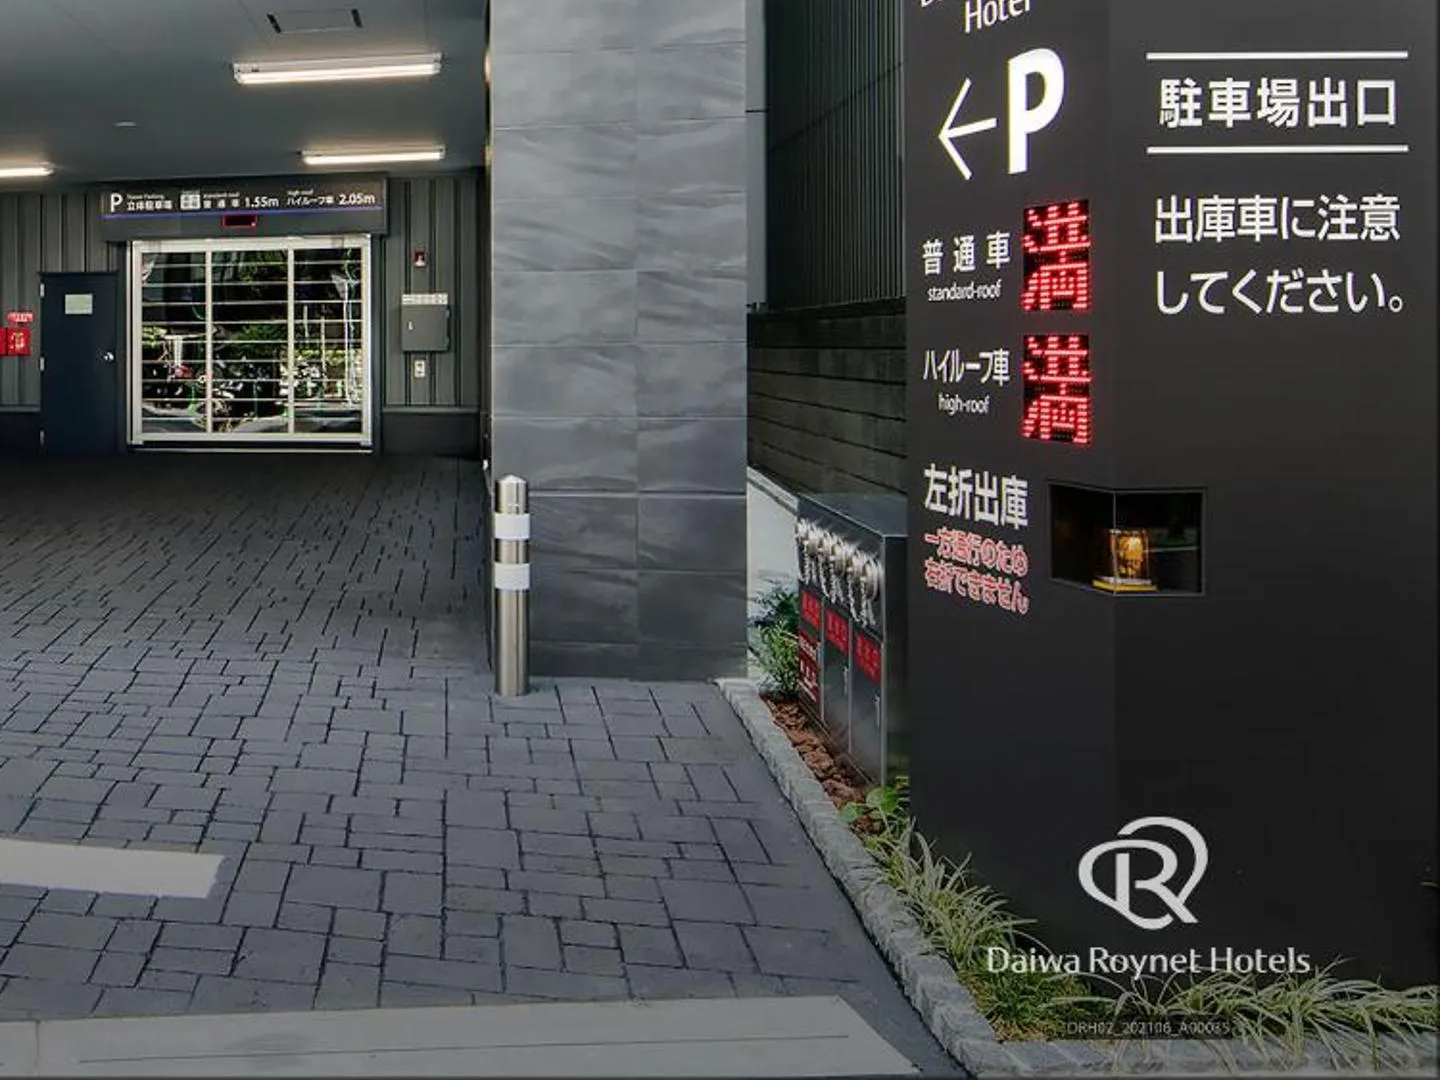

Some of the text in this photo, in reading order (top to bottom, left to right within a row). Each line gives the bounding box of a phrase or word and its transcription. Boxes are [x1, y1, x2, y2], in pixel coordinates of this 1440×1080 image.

[1007, 48, 1065, 175] P
[1159, 77, 1396, 129] 駐車場出口
[110, 193, 123, 212] P
[245, 196, 279, 208] 1.55m
[339, 193, 375, 206] 2.05m
[1155, 193, 1401, 243] 出庫車に注意
[922, 230, 1011, 275] 普通車
[1021, 202, 1092, 311] 満
[927, 278, 1002, 302] standard-roof
[1157, 267, 1403, 315] してください。
[923, 348, 1010, 387] ハイルーフ車
[1021, 336, 1092, 444] 満
[938, 393, 990, 416] high-roof
[924, 463, 1028, 530] 左折出庫
[924, 556, 1030, 615] 右折できません
